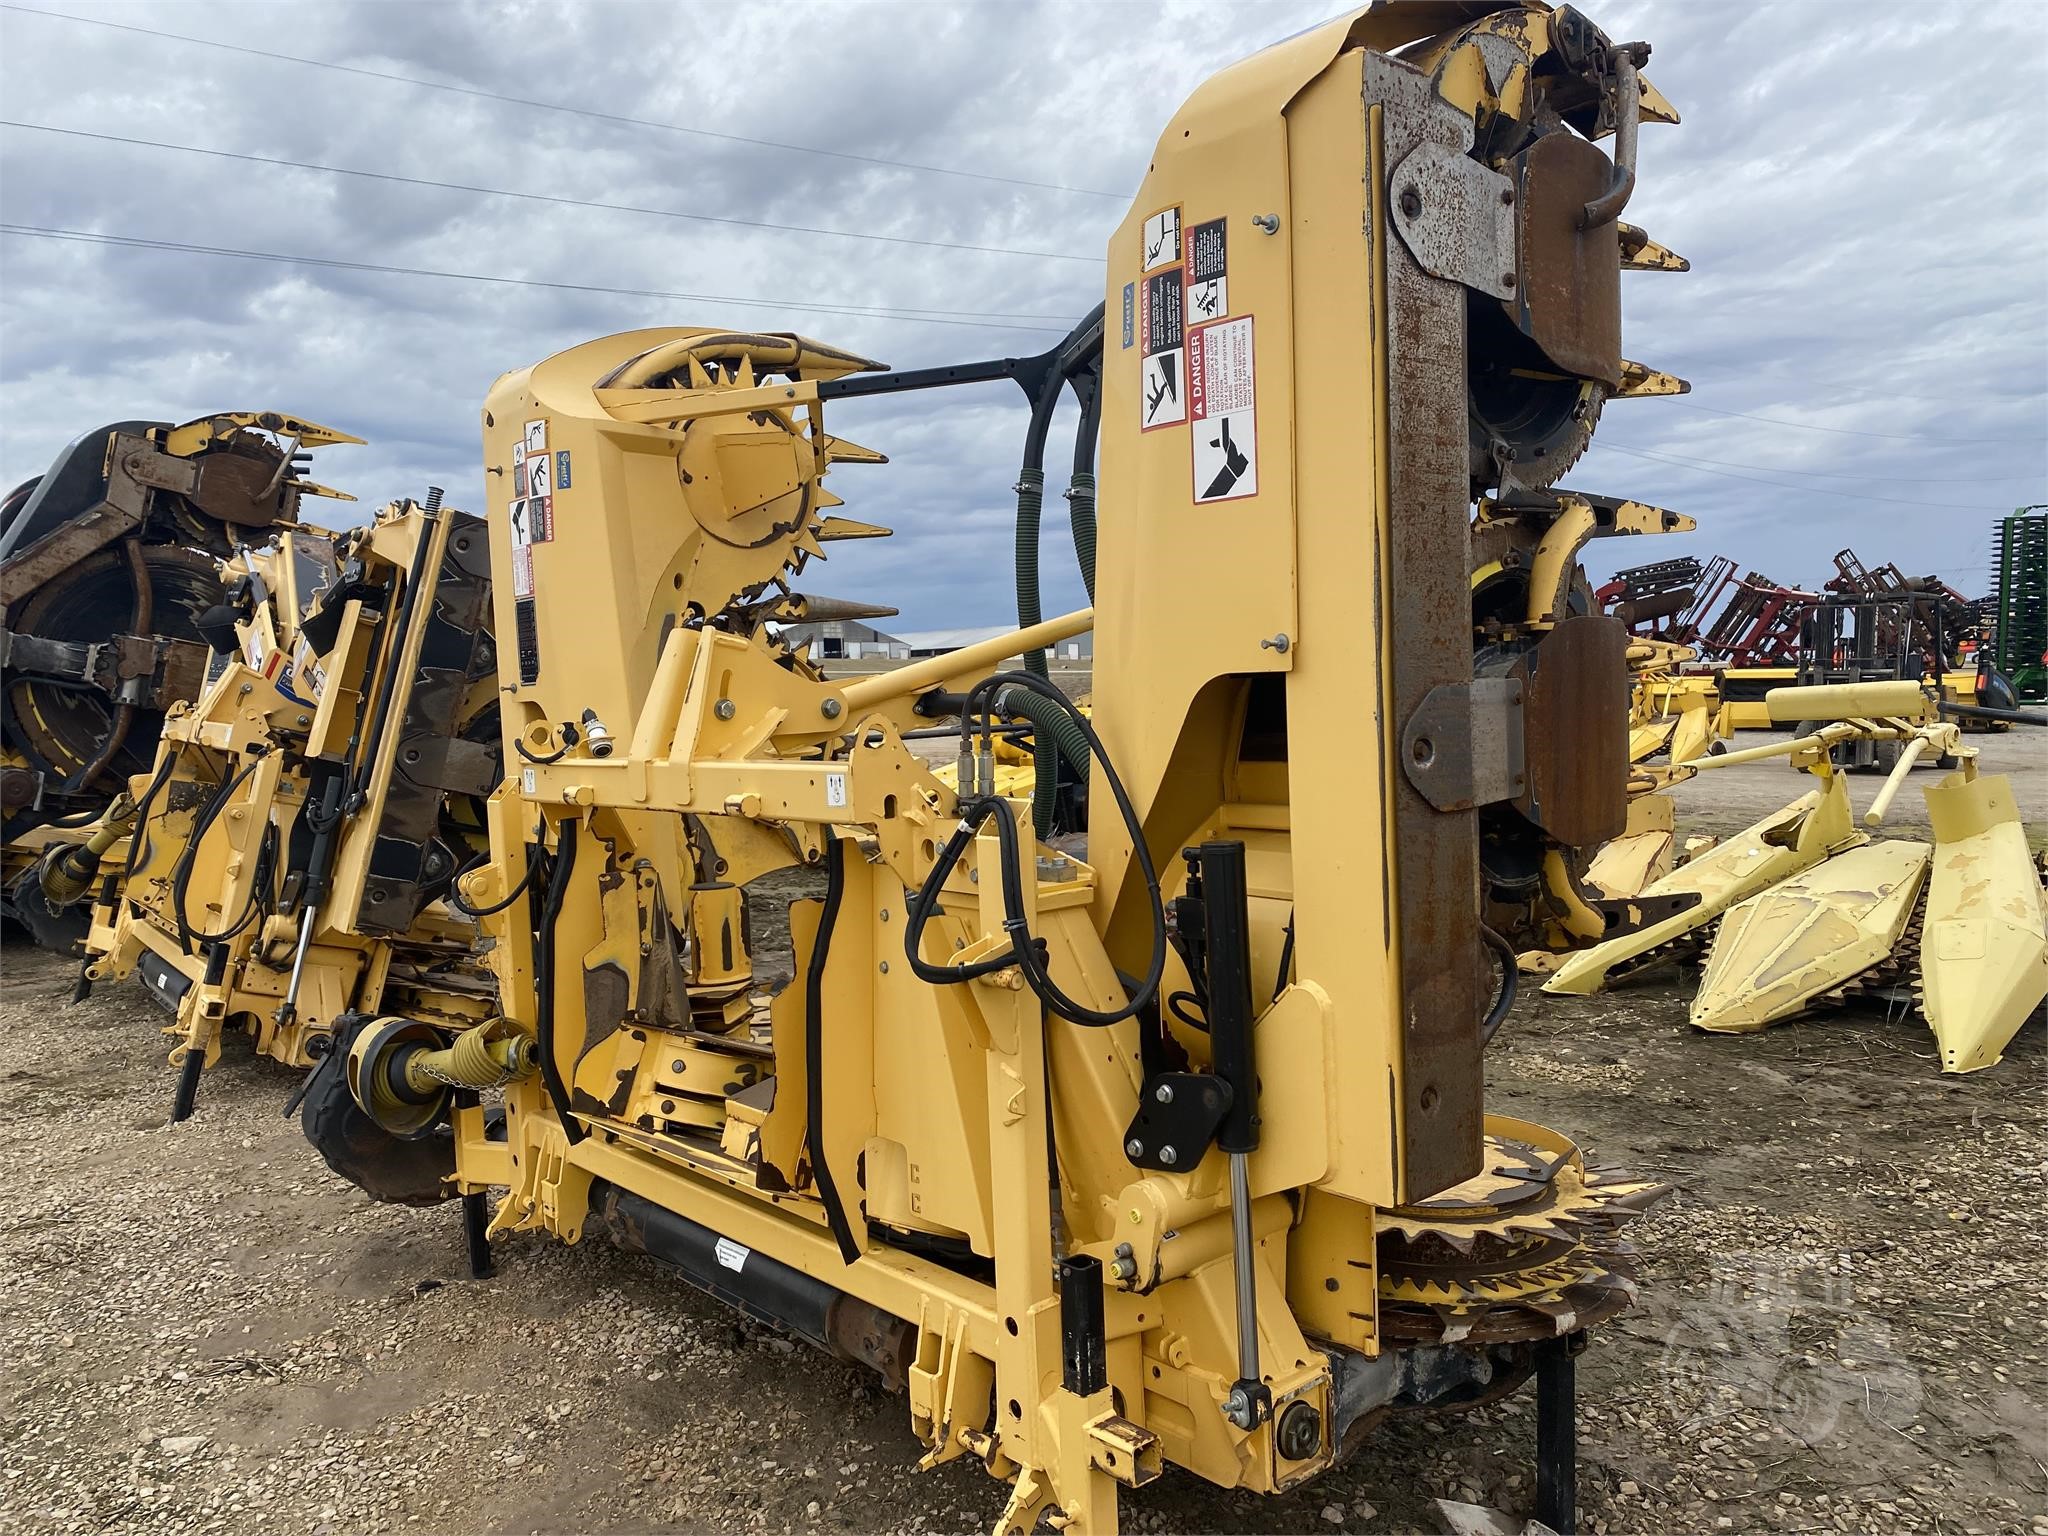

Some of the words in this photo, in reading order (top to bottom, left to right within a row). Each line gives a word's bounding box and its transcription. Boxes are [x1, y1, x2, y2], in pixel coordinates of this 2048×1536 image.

[1176, 240, 1180, 249] Do
[1214, 357, 1219, 366] OF
[1191, 335, 1201, 398] DANGER
[1207, 405, 1211, 413] TO
[1212, 403, 1216, 413] OR
